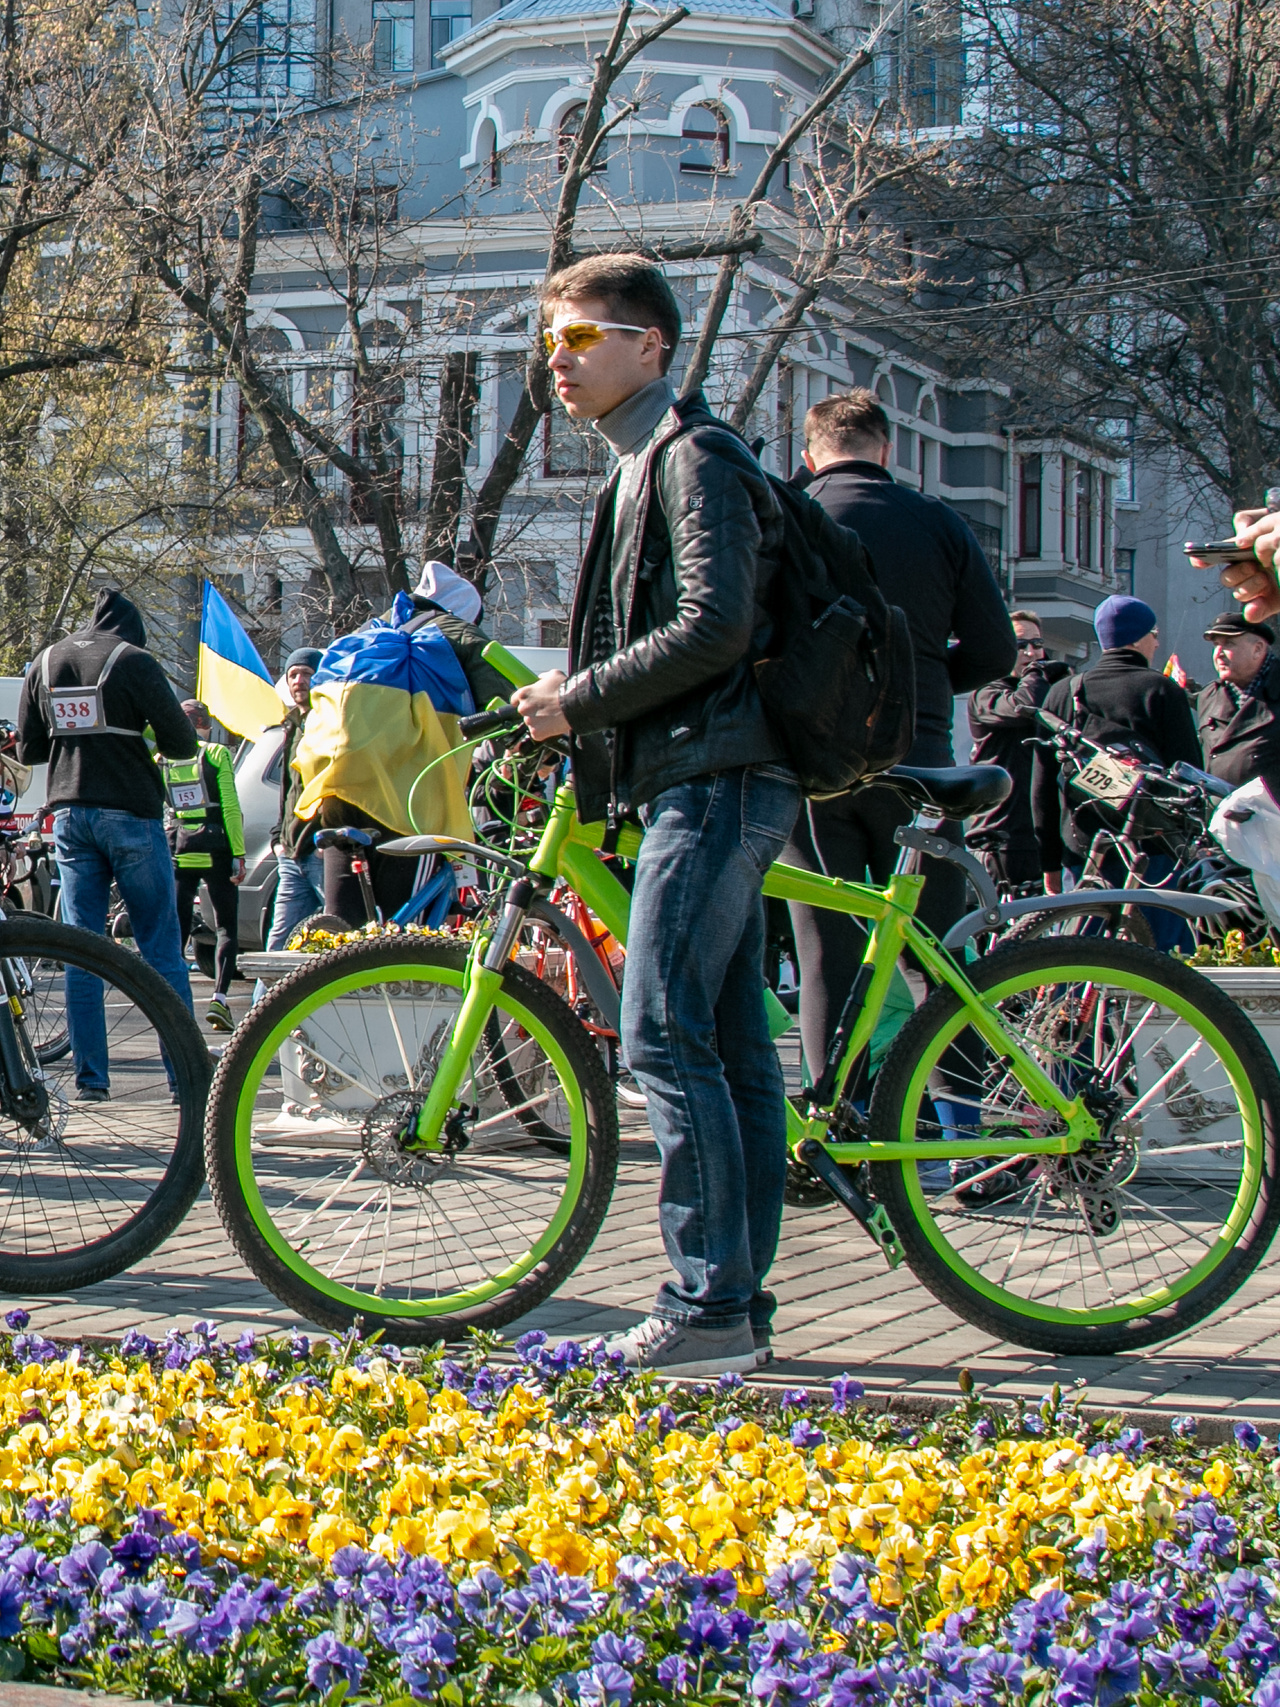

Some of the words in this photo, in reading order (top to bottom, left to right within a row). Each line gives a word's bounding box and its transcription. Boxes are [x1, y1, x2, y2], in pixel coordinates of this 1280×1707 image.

[55, 701, 90, 718] 338
[1081, 767, 1113, 790] 1279
[178, 791, 195, 802] 153
